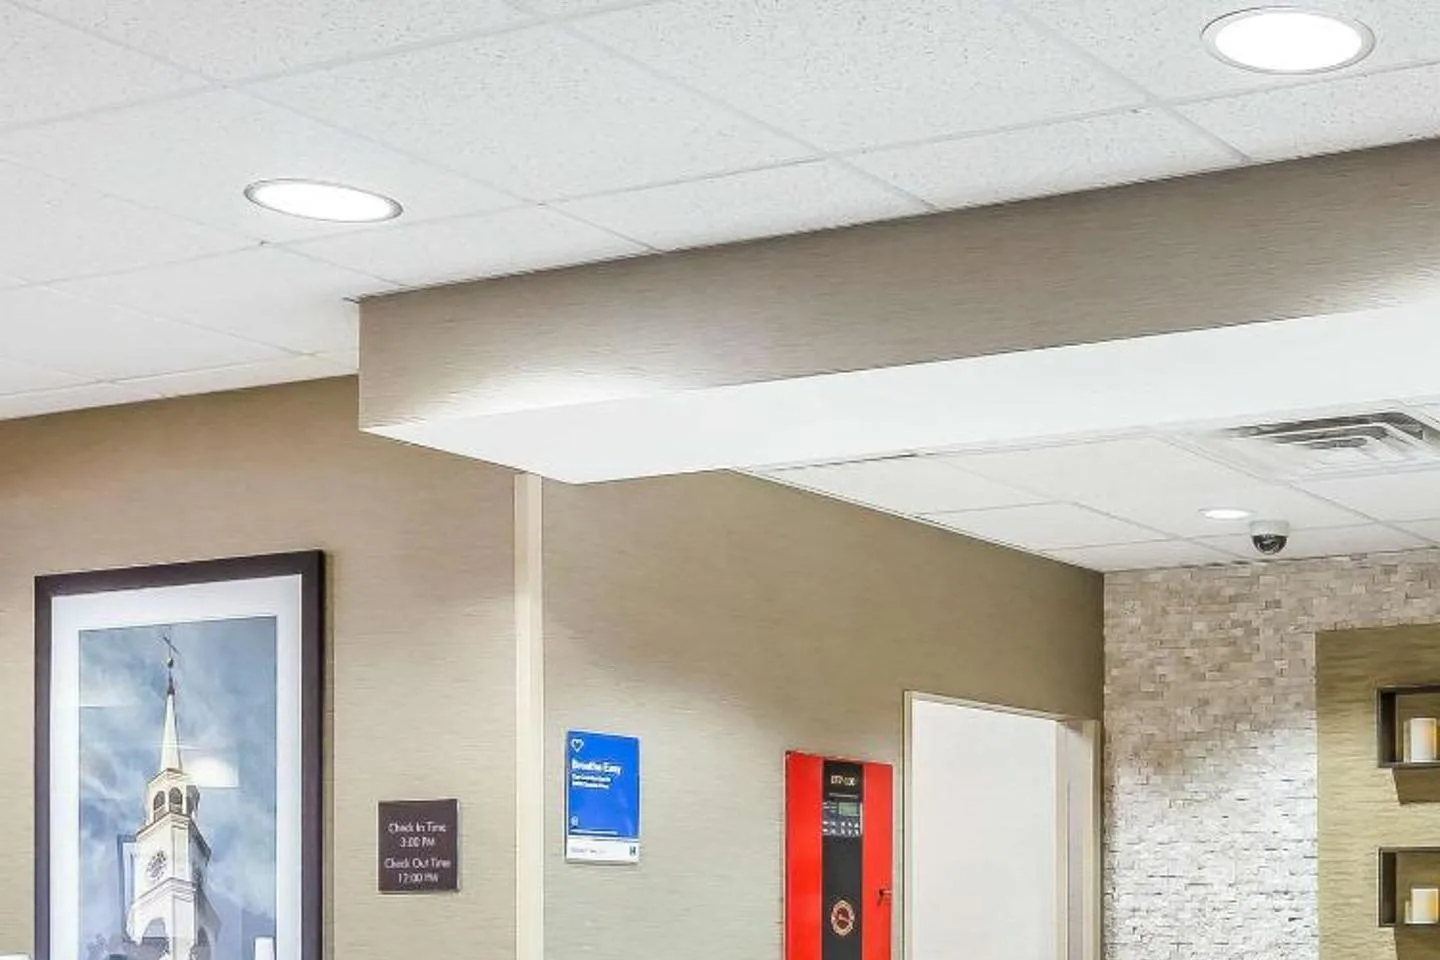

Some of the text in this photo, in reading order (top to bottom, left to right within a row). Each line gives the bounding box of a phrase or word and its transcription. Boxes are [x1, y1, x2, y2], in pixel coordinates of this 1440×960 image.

[387, 821, 414, 834] Check
[425, 821, 447, 833] Time
[399, 836, 436, 848] 3:00 PM
[384, 857, 451, 869] Check Out Time
